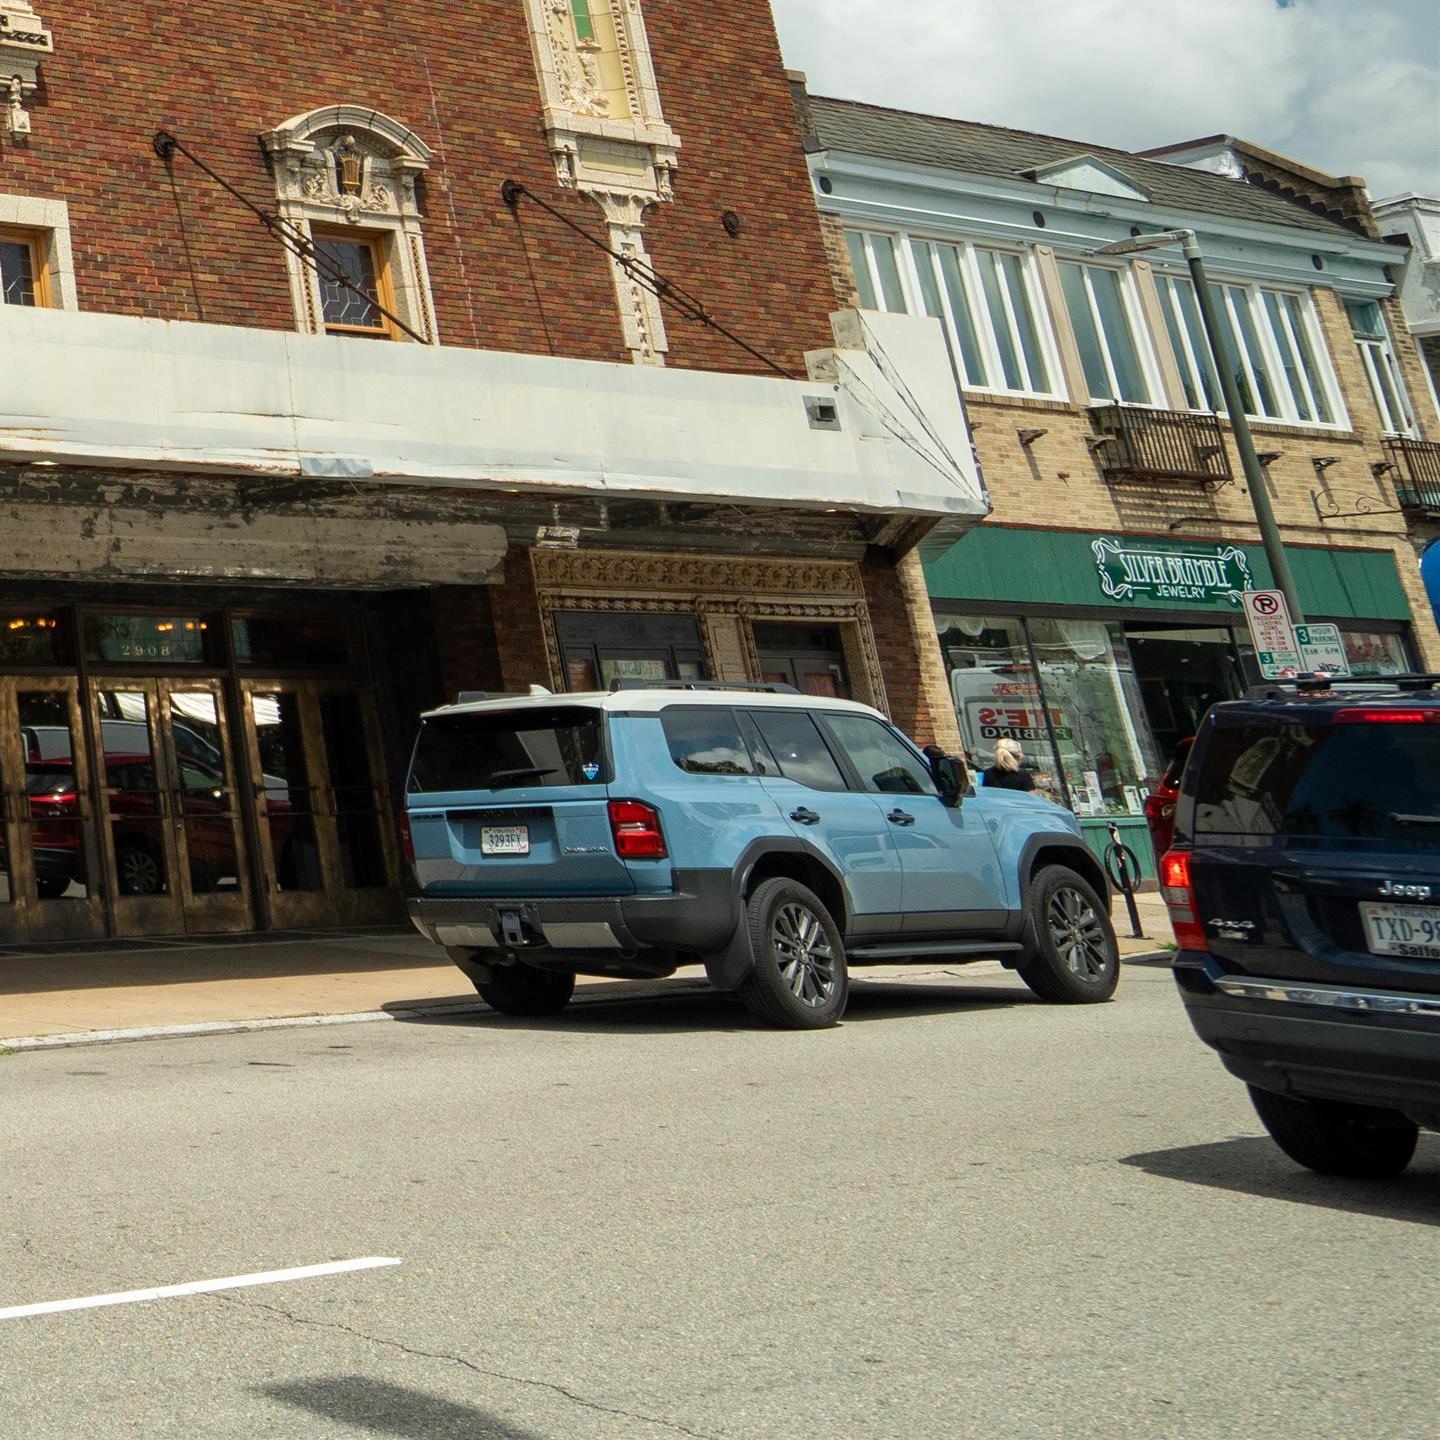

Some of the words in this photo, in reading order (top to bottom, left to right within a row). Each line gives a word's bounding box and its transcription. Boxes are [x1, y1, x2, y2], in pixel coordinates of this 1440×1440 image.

[1120, 554, 1168, 583] SILVER
[1169, 558, 1232, 587] BRAMBLE
[1156, 585, 1206, 598] JEWELRY
[1298, 629, 1310, 642] 3
[122, 644, 170, 657] 2908
[1263, 652, 1271, 663] 3
[1378, 880, 1431, 900] Jeep
